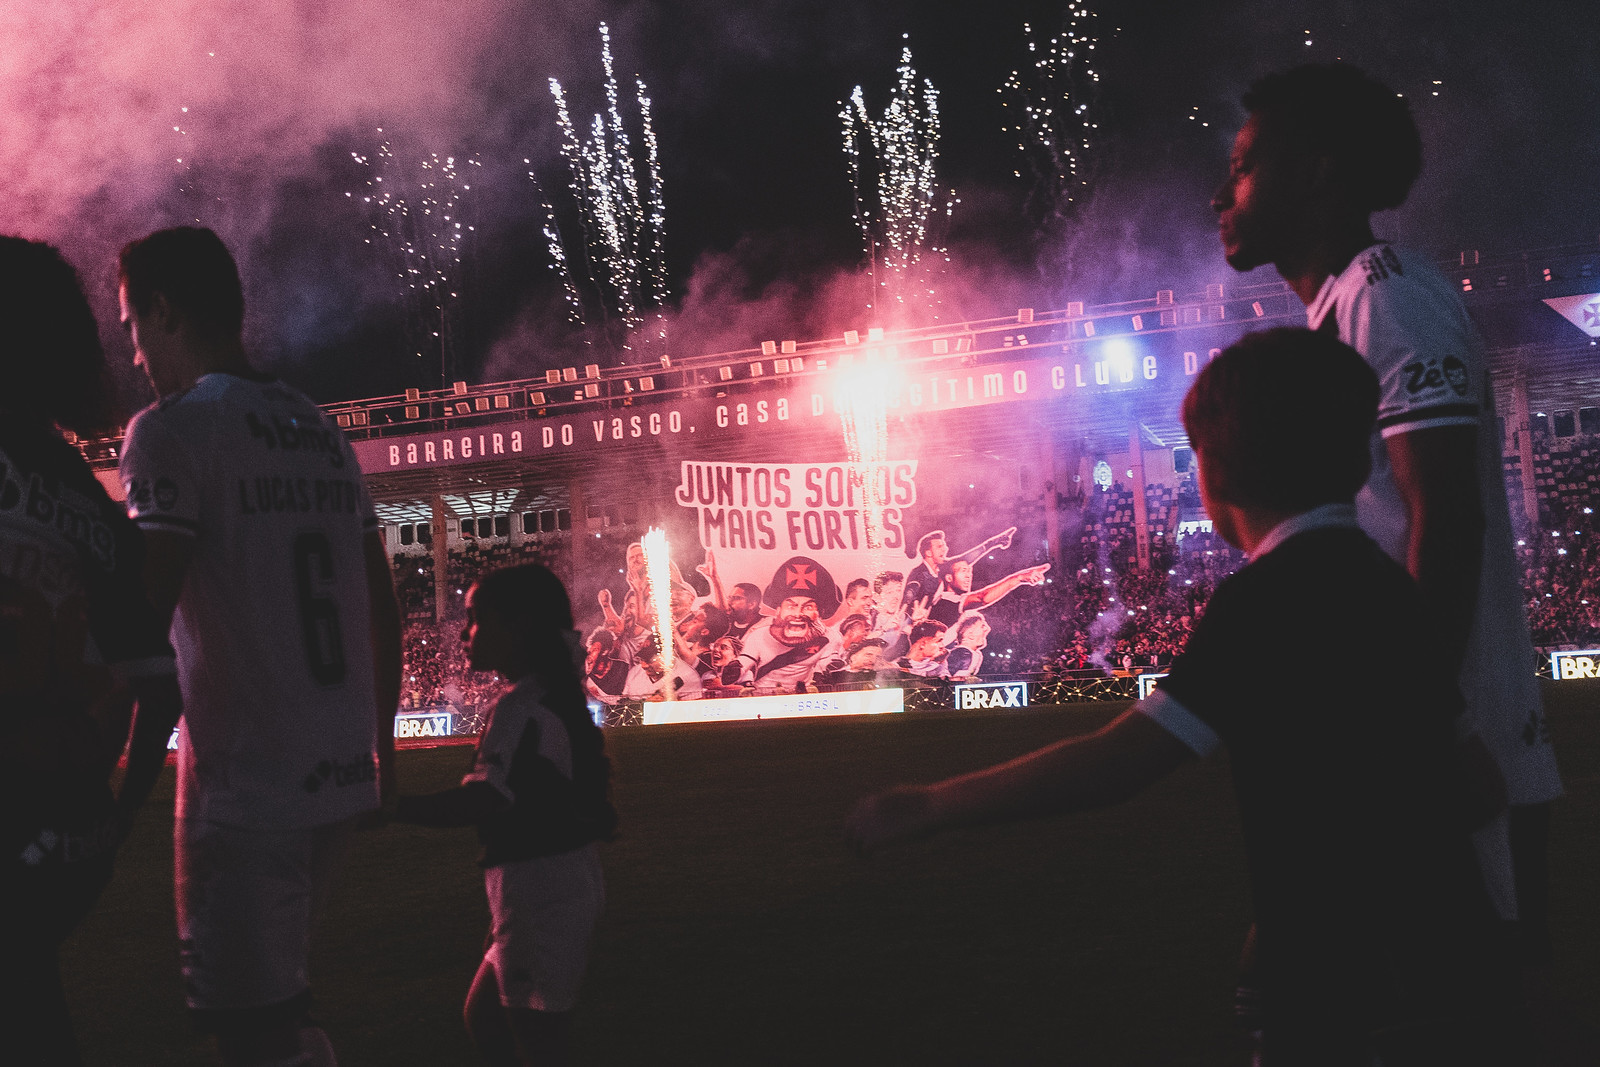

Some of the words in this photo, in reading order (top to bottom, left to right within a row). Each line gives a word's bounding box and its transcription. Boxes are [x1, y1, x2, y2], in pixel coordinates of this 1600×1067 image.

[542, 424, 574, 448] DO
[238, 476, 311, 515] LUCAS
[678, 464, 791, 508] JUNTOS
[704, 507, 776, 550] MAIS
[294, 530, 348, 689] 6
[1560, 656, 1600, 680] BR
[961, 687, 1021, 710] BRAX
[398, 717, 447, 738] BRAX
